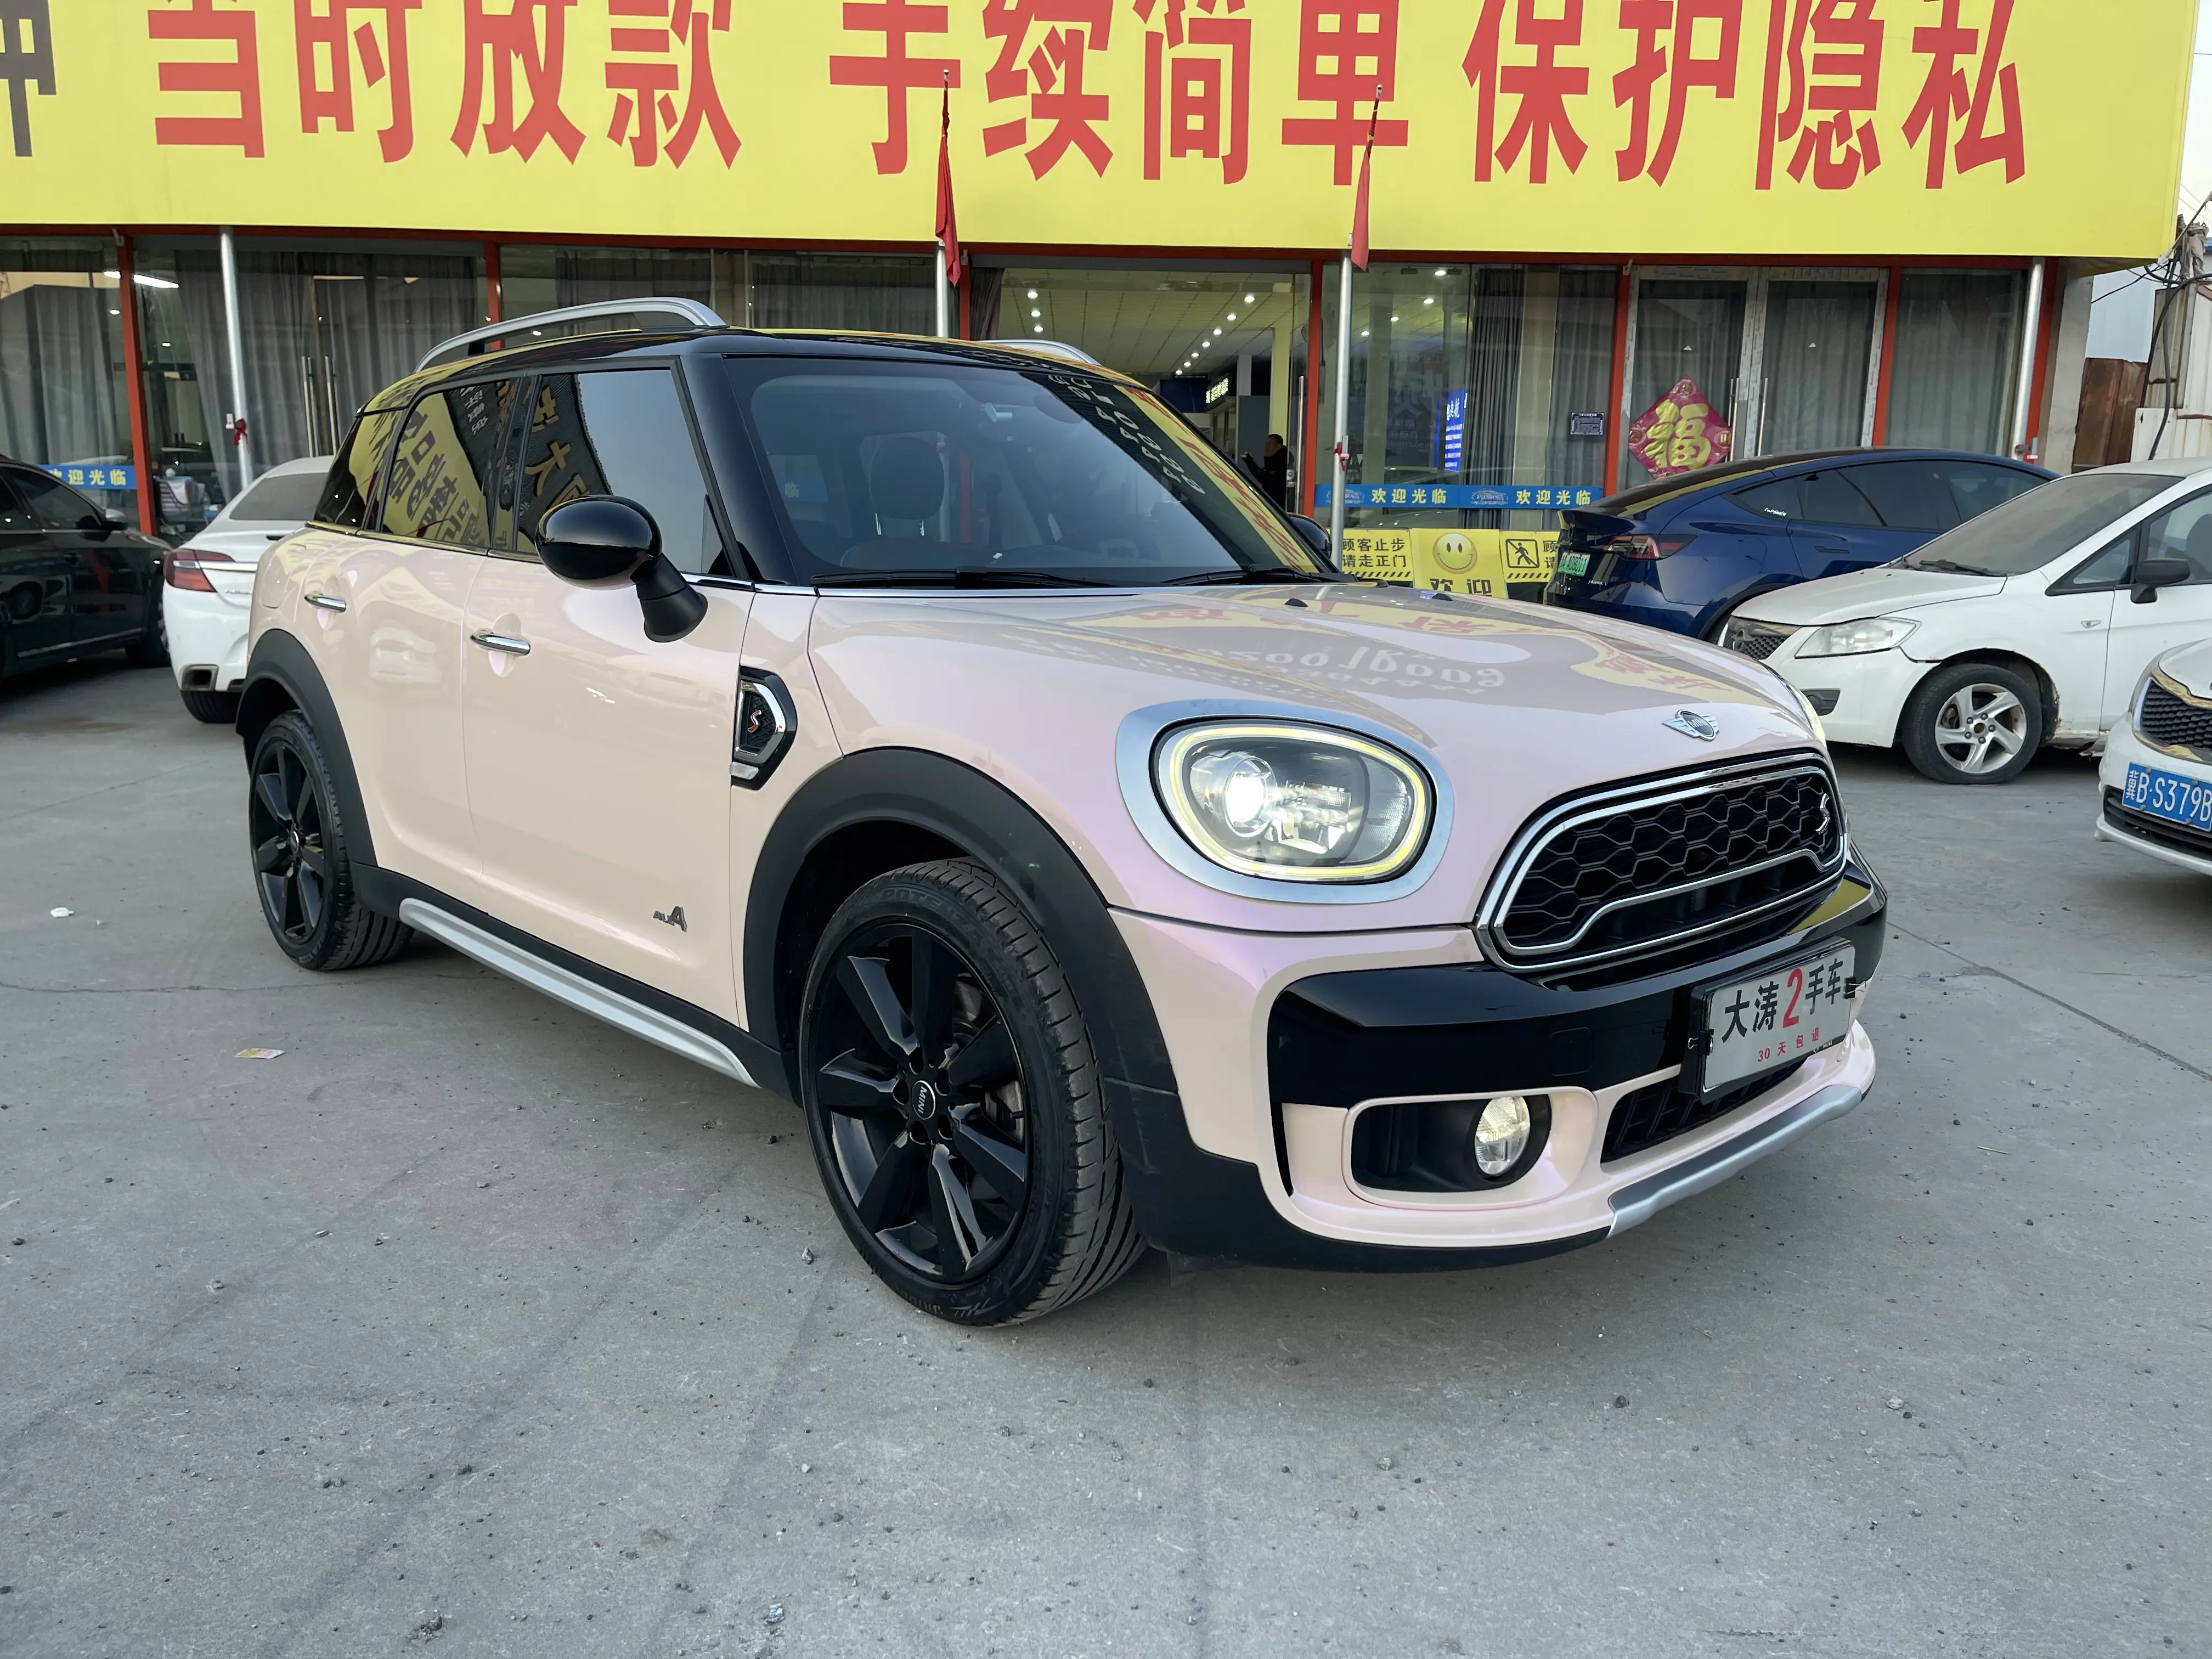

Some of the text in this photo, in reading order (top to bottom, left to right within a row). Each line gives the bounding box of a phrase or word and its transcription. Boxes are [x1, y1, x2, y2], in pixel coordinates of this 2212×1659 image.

[147, 0, 742, 170] 当时放款
[829, 0, 1409, 186] 手续简单
[1462, 0, 2026, 190] 保护隐私
[1644, 399, 1711, 470] 福
[48, 469, 126, 486] 迎光临
[1371, 488, 1447, 504] 欢迎光临
[1516, 489, 1592, 505] 欢迎光临
[1342, 538, 1406, 552] 顾客止步
[1342, 554, 1407, 567] 请走正门
[881, 887, 981, 951] POTENZA
[1722, 958, 1844, 1043] 大涛2手车
[917, 1086, 927, 1114] MINI
